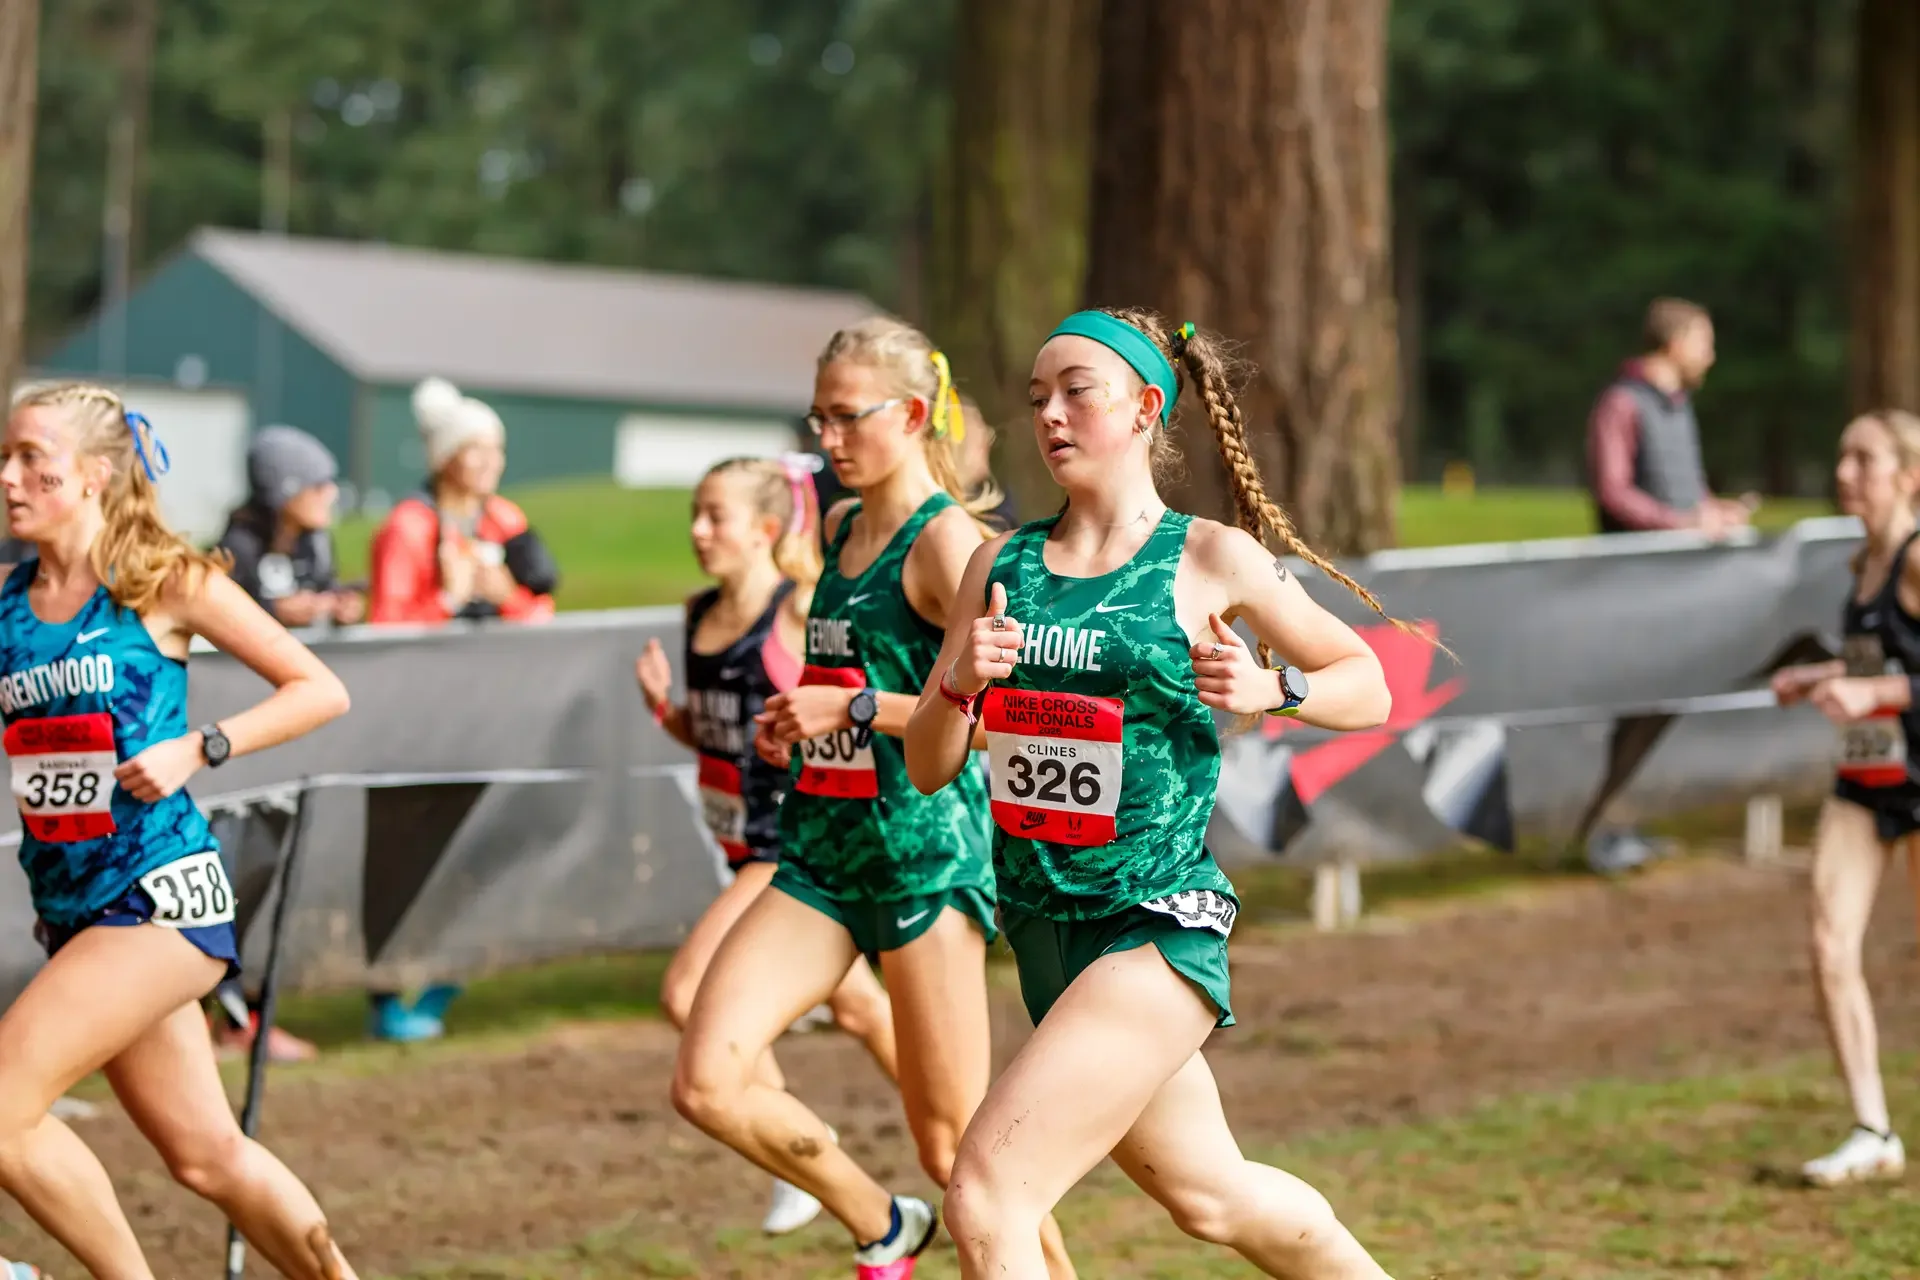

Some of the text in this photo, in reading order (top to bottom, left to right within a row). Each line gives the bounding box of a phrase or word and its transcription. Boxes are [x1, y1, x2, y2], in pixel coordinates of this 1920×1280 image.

[1003, 694, 1098, 716] NIKE CROSS
[1005, 708, 1095, 729] NATIONALS
[1027, 743, 1077, 758] CLINES
[24, 771, 100, 808] 358
[1007, 754, 1101, 806] 326
[1026, 810, 1047, 824] RUN
[152, 862, 227, 920] 358
